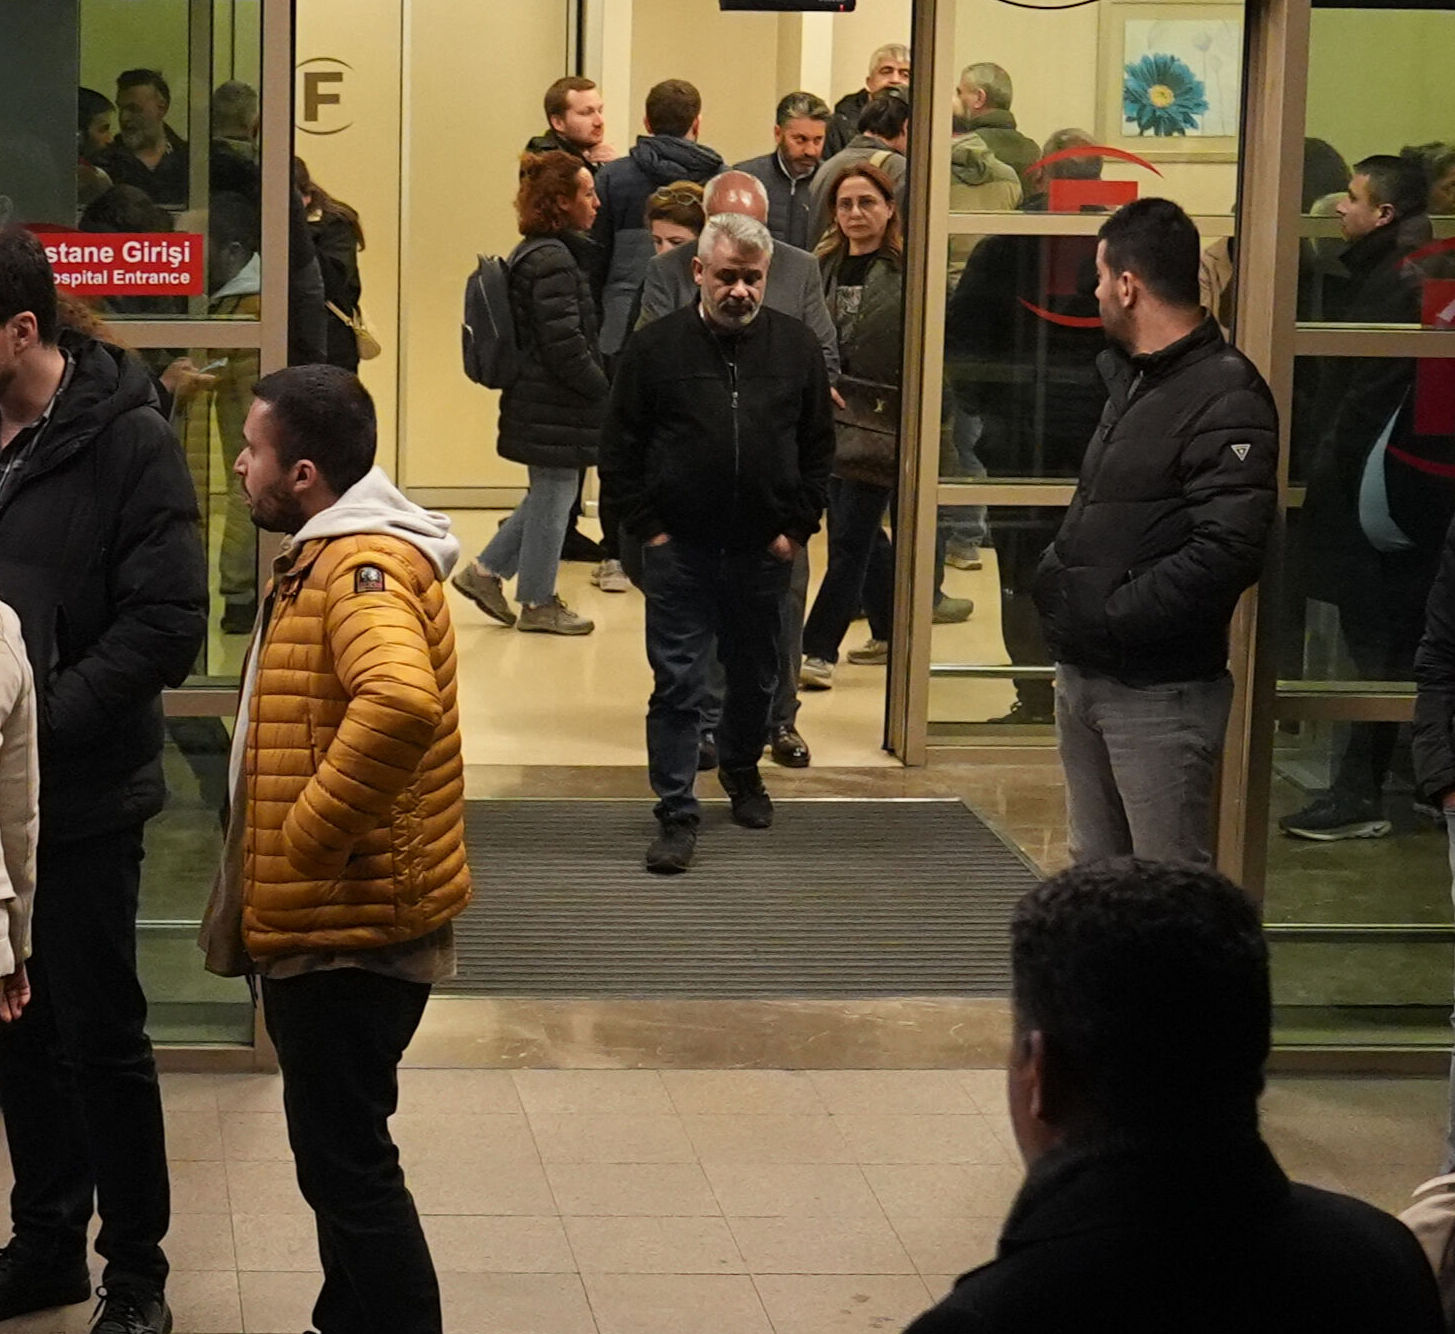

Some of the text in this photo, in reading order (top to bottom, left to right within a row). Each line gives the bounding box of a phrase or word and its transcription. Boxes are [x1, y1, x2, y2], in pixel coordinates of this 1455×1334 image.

[44, 240, 191, 268] stane Girişi
[53, 269, 191, 288] ospital Entrance
